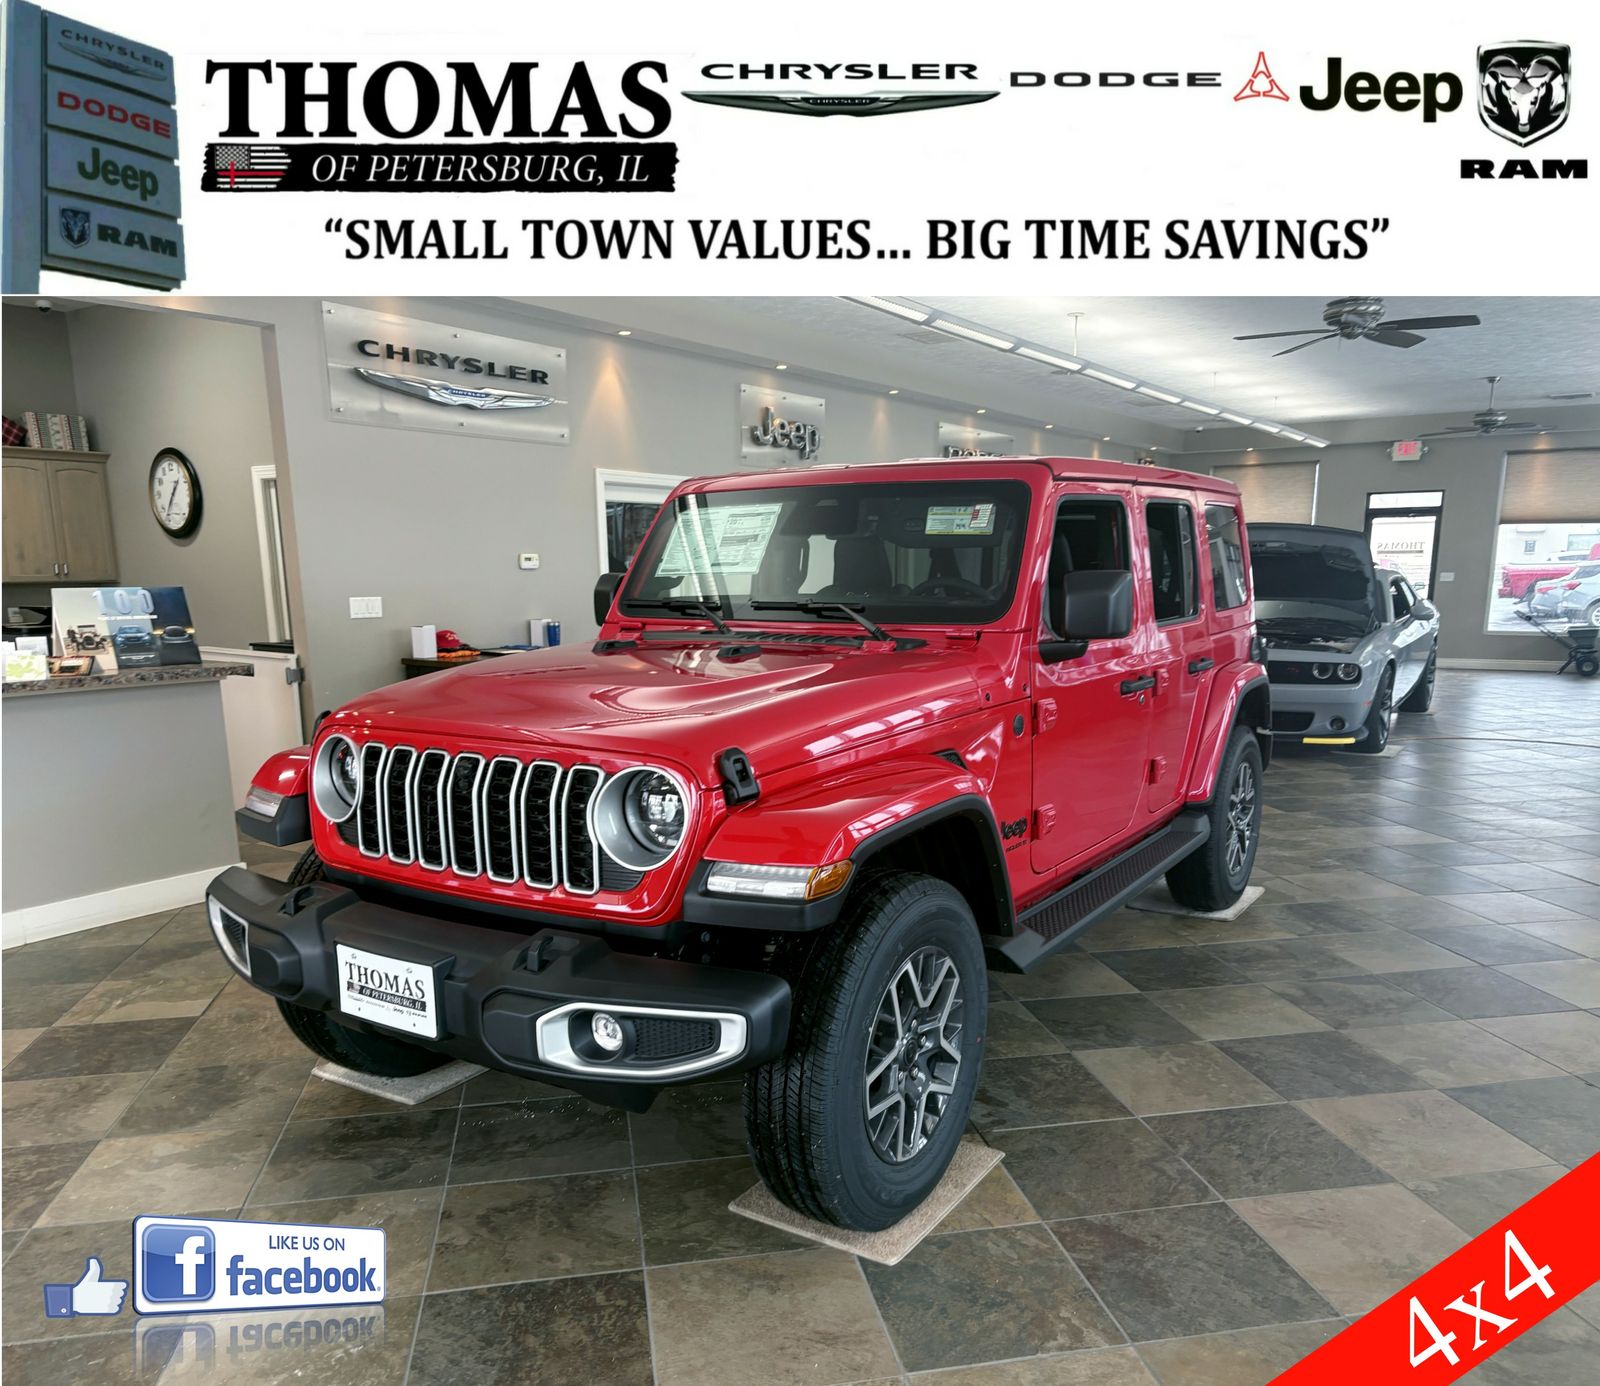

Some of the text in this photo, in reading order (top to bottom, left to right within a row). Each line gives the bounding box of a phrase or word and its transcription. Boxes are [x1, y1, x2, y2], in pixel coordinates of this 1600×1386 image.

[356, 339, 549, 385] CHRYSLER
[752, 406, 820, 461] Jeep
[92, 589, 155, 615] 100
[345, 961, 426, 1000] THOMAS
